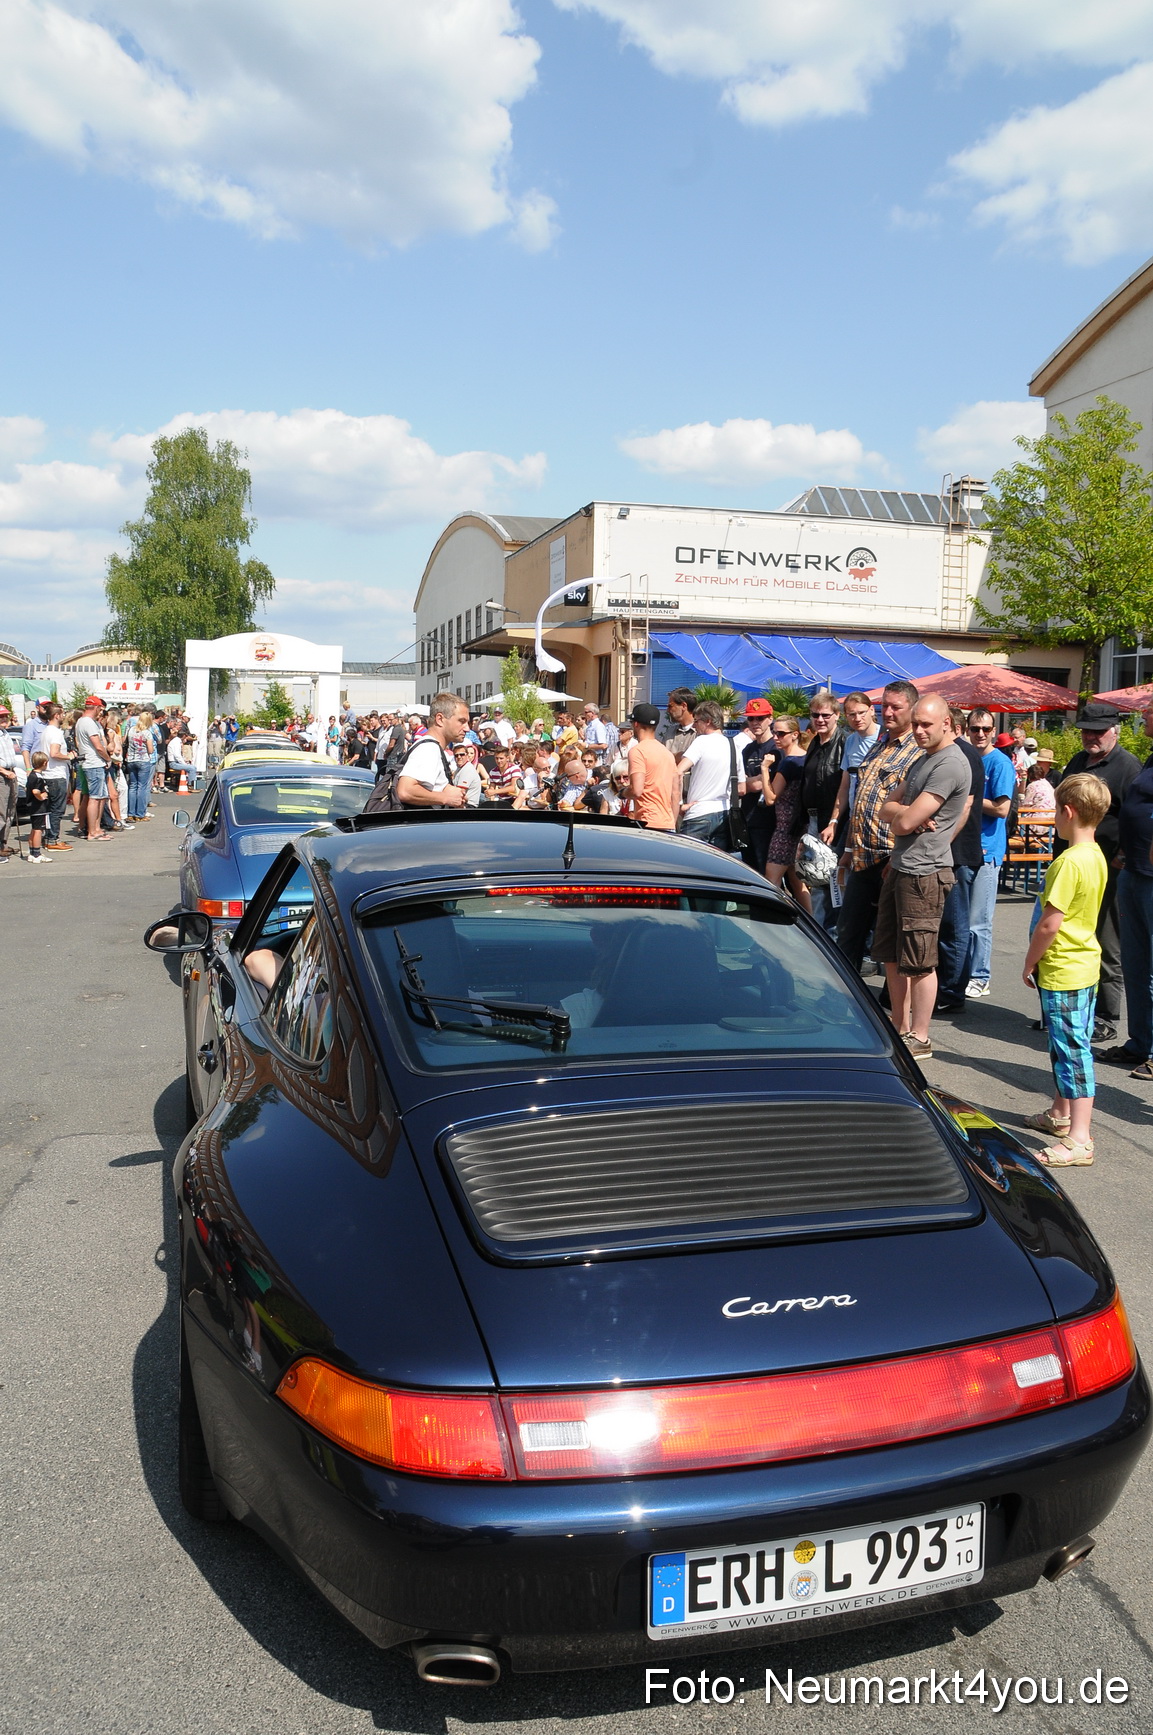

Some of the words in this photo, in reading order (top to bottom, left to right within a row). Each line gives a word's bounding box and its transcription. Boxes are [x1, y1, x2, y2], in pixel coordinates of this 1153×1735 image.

[675, 546, 842, 573] OFENWERK
[674, 573, 739, 586] ZENTRUM
[743, 576, 768, 587] FÜR
[774, 578, 821, 590] MOBILE
[825, 581, 878, 593] CLASSIC
[567, 590, 586, 602] sky
[721, 1294, 858, 1318] Carrera
[955, 1513, 974, 1530] 04
[662, 1597, 675, 1613] D
[688, 1547, 785, 1613] ERH
[825, 1539, 851, 1593] L
[867, 1518, 949, 1585] 993
[956, 1549, 973, 1566] 10
[661, 1624, 708, 1635] OFENWERK
[728, 1588, 918, 1628] WWW.OFENWERK.DE
